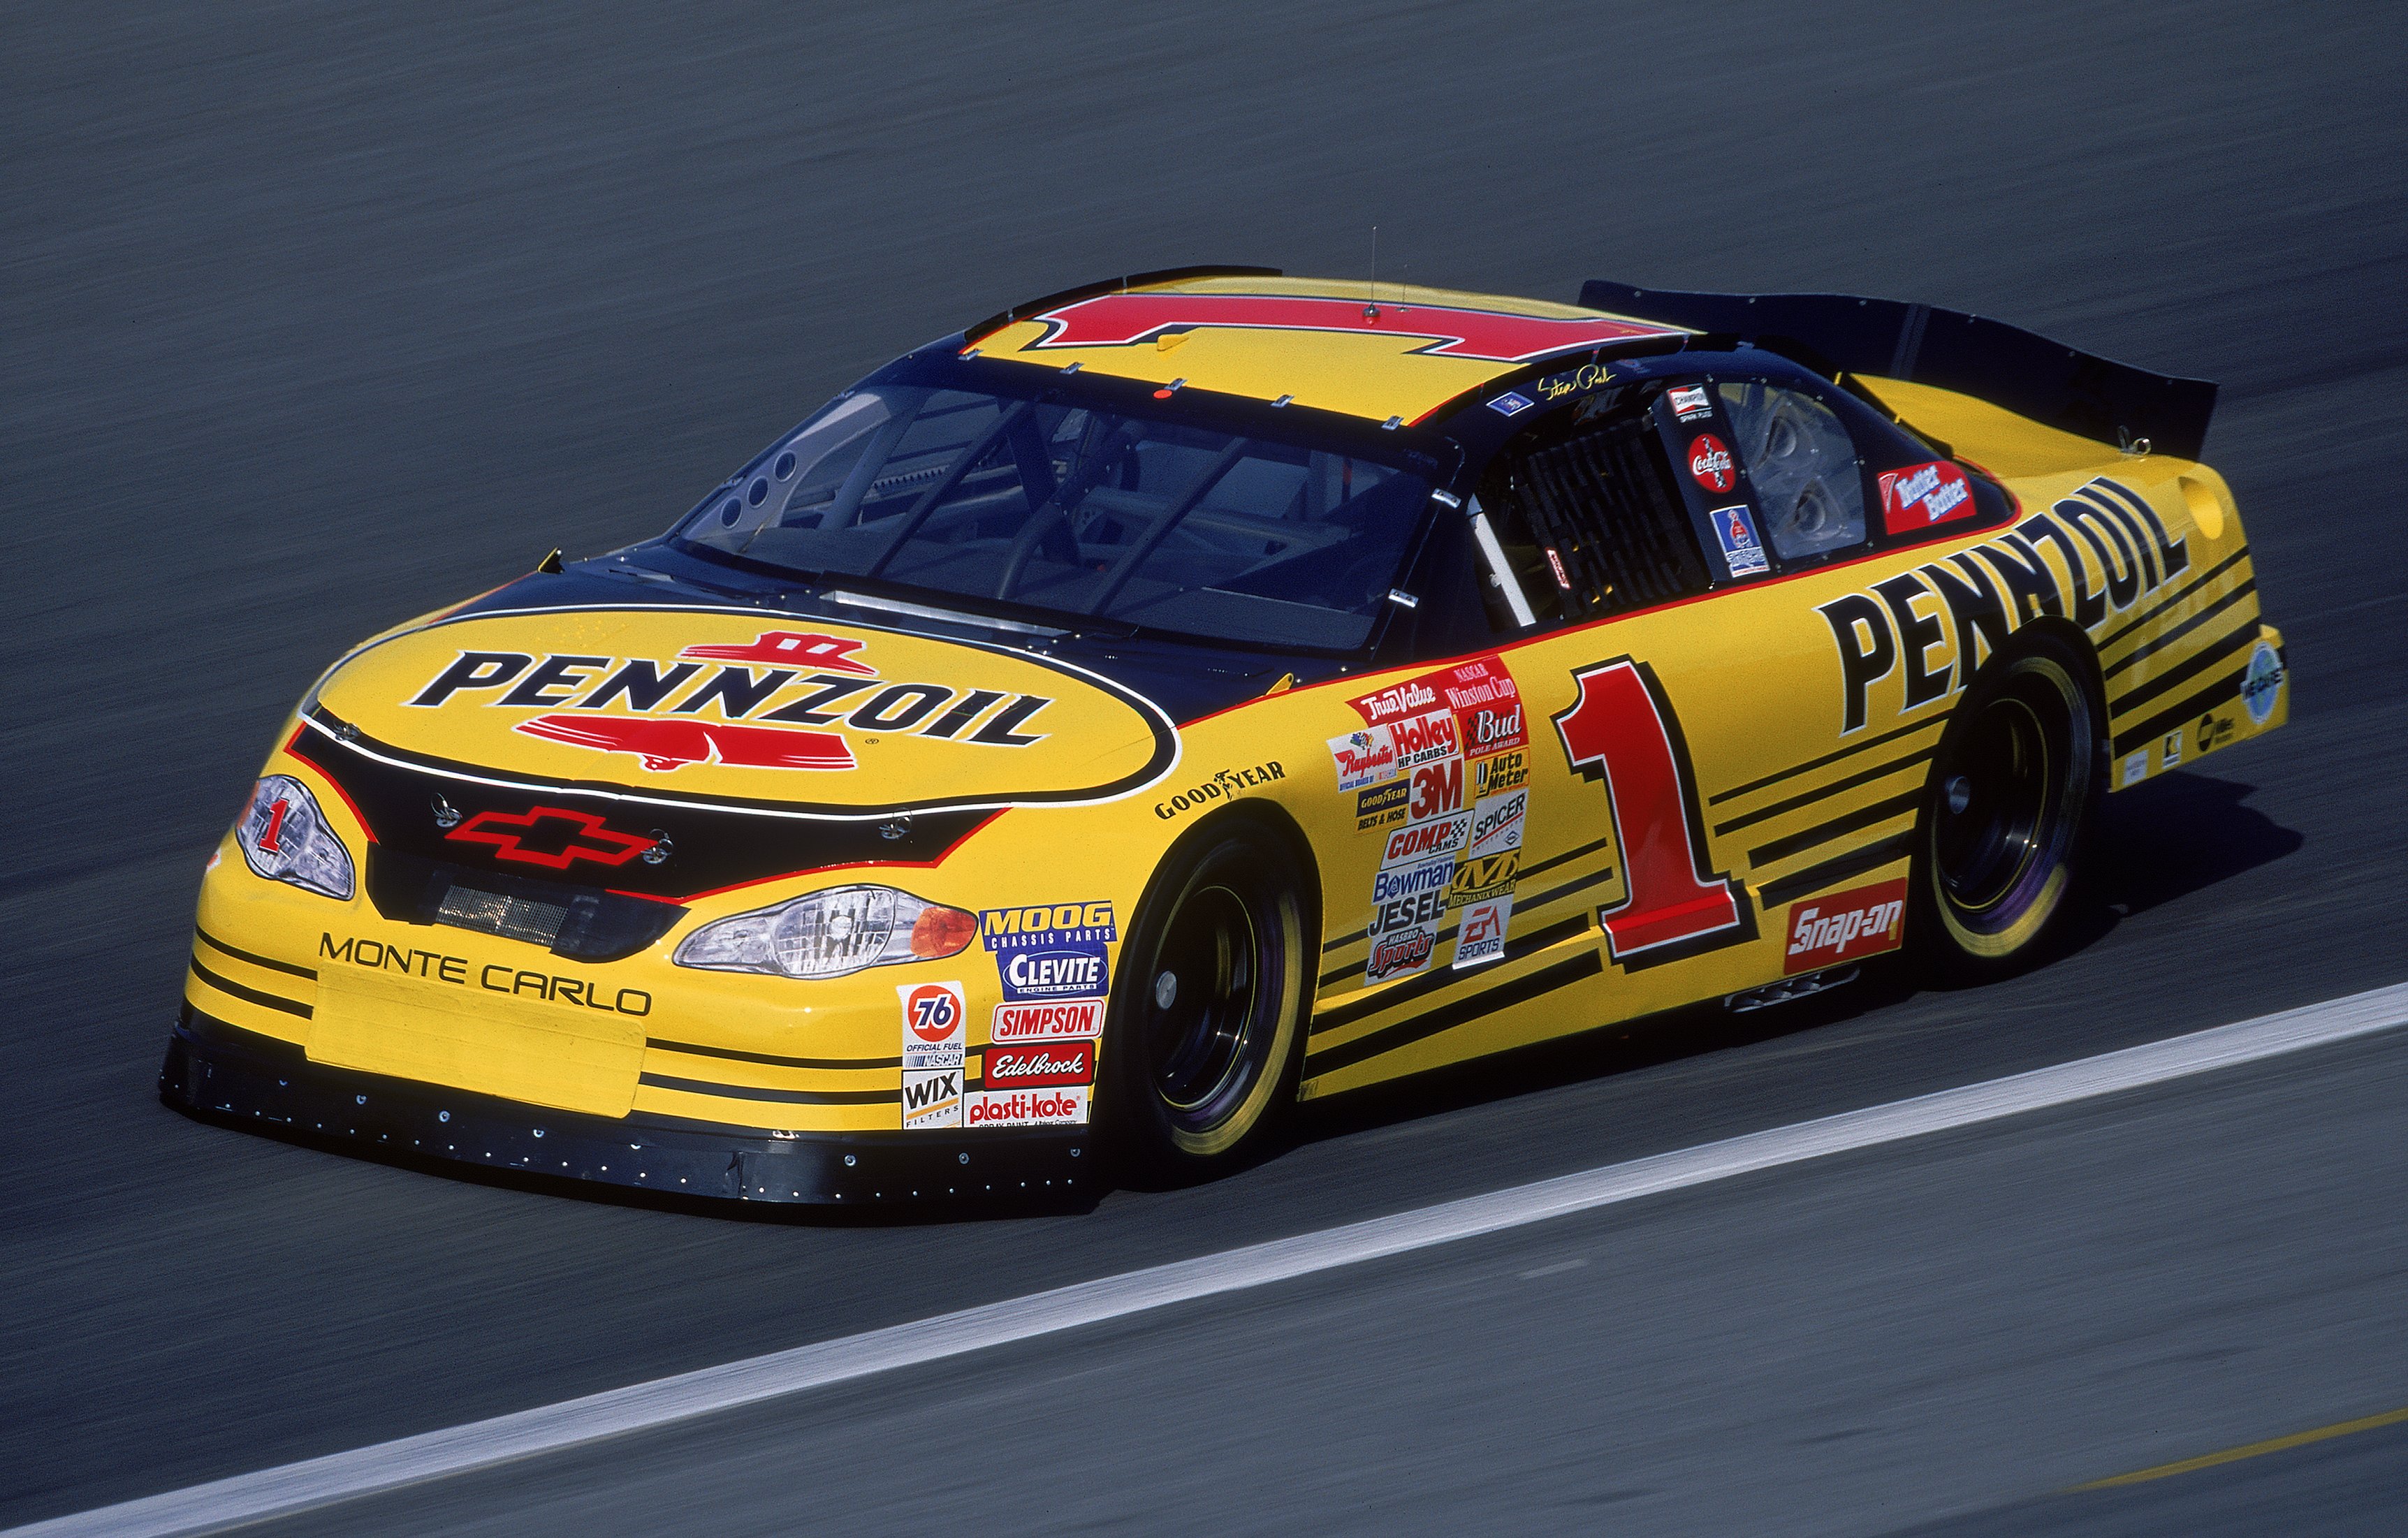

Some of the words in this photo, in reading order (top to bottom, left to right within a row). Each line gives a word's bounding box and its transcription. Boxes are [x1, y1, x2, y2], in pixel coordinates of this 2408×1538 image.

[1819, 476, 2189, 738] PENNZOIL
[1454, 664, 1489, 682] NASCAR
[400, 650, 1056, 747] PENNZOIL
[1445, 682, 1494, 709] Winston
[1489, 676, 1516, 698] Cup
[1389, 717, 1457, 757] Holley
[1477, 703, 1521, 743] Bud
[1398, 755, 1412, 768] HP
[1414, 746, 1447, 763] CARBS
[1470, 745, 1490, 756] POLE
[1491, 737, 1520, 750] AWARD
[1489, 768, 1528, 790] Meter
[1491, 754, 1522, 774] Auto
[1410, 759, 1462, 819] 3M
[258, 797, 290, 855] 1
[1357, 815, 1378, 830] BELTS
[1379, 814, 1385, 824] &
[1387, 807, 1406, 823] HOSE
[1474, 791, 1526, 840] SPICER
[1552, 655, 1748, 965] 1
[1387, 821, 1452, 860] COMP
[1428, 838, 1459, 854] CAMS
[1373, 861, 1454, 902] Bowman
[1450, 888, 1489, 907] MECHANIX
[1490, 879, 1516, 899] WEAR
[984, 902, 1112, 936] MOOG
[1368, 888, 1446, 937] JESEL
[1789, 900, 1903, 955] Snap-on
[991, 932, 1054, 950] CHASSIS
[1065, 928, 1111, 943] PARTS
[1369, 932, 1433, 974] Sports
[1388, 929, 1419, 945] HASBRO
[1458, 937, 1500, 960] SPORTS
[319, 932, 468, 985] MONTE
[481, 964, 652, 1018] CARLO
[1009, 953, 1101, 986] CLEVITE
[1019, 985, 1058, 993] ENGINE
[1062, 983, 1095, 991] PARTS
[914, 993, 954, 1030] 76
[1000, 1005, 1095, 1037] SIMPSON
[906, 1043, 941, 1052] OFFICIAL
[924, 1053, 963, 1067] NASCAR
[992, 1053, 1084, 1078] Edelbrock
[905, 1071, 958, 1109] WIX
[906, 1105, 958, 1128] FILTERS
[970, 1092, 1077, 1125] plasti-kote
